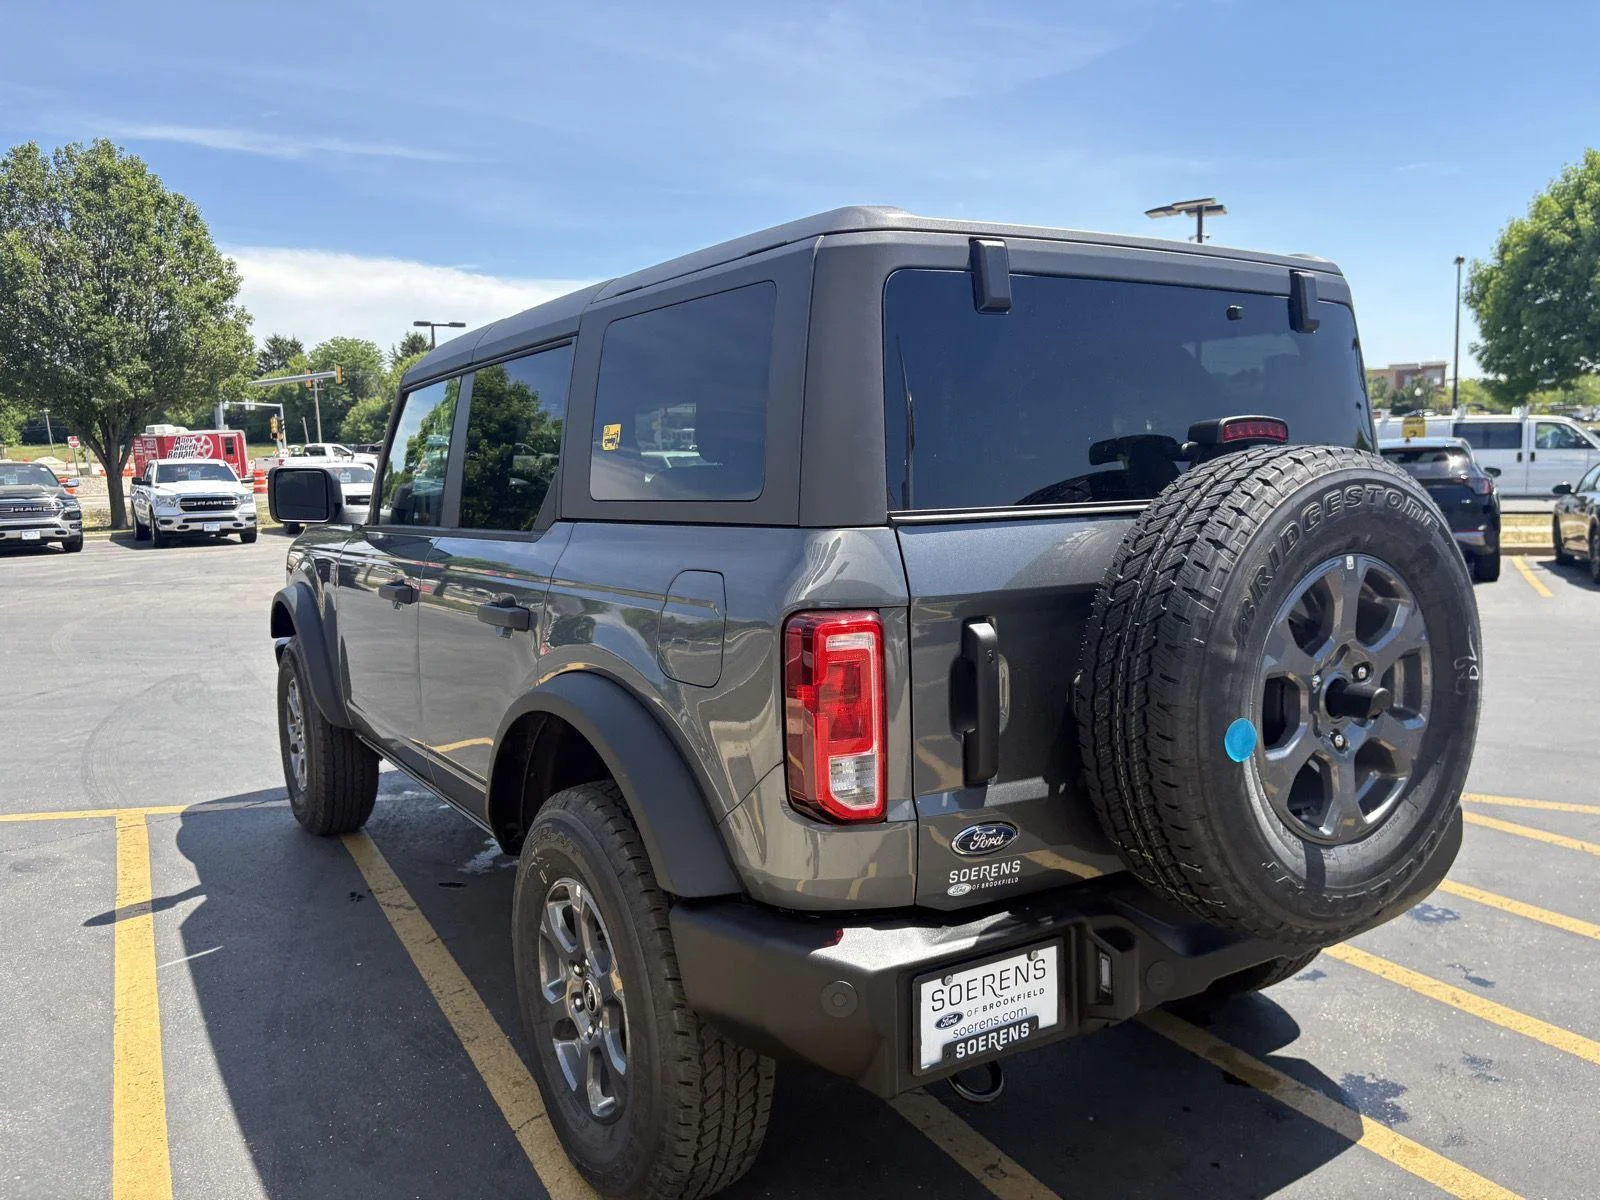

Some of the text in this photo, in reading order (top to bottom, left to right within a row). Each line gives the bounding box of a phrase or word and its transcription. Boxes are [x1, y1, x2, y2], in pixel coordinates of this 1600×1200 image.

[1233, 484, 1440, 647] BRIDGESTONE
[948, 860, 1021, 884] SOERENS
[971, 883, 980, 891] OF
[981, 876, 1019, 890] BROOKFIELD
[931, 958, 1046, 1012] SOERENS
[966, 1008, 979, 1018] OF
[982, 987, 1045, 1013] BROOKFIELD
[953, 1006, 1028, 1039] soerens.com
[956, 1022, 1030, 1059] SOERENS
